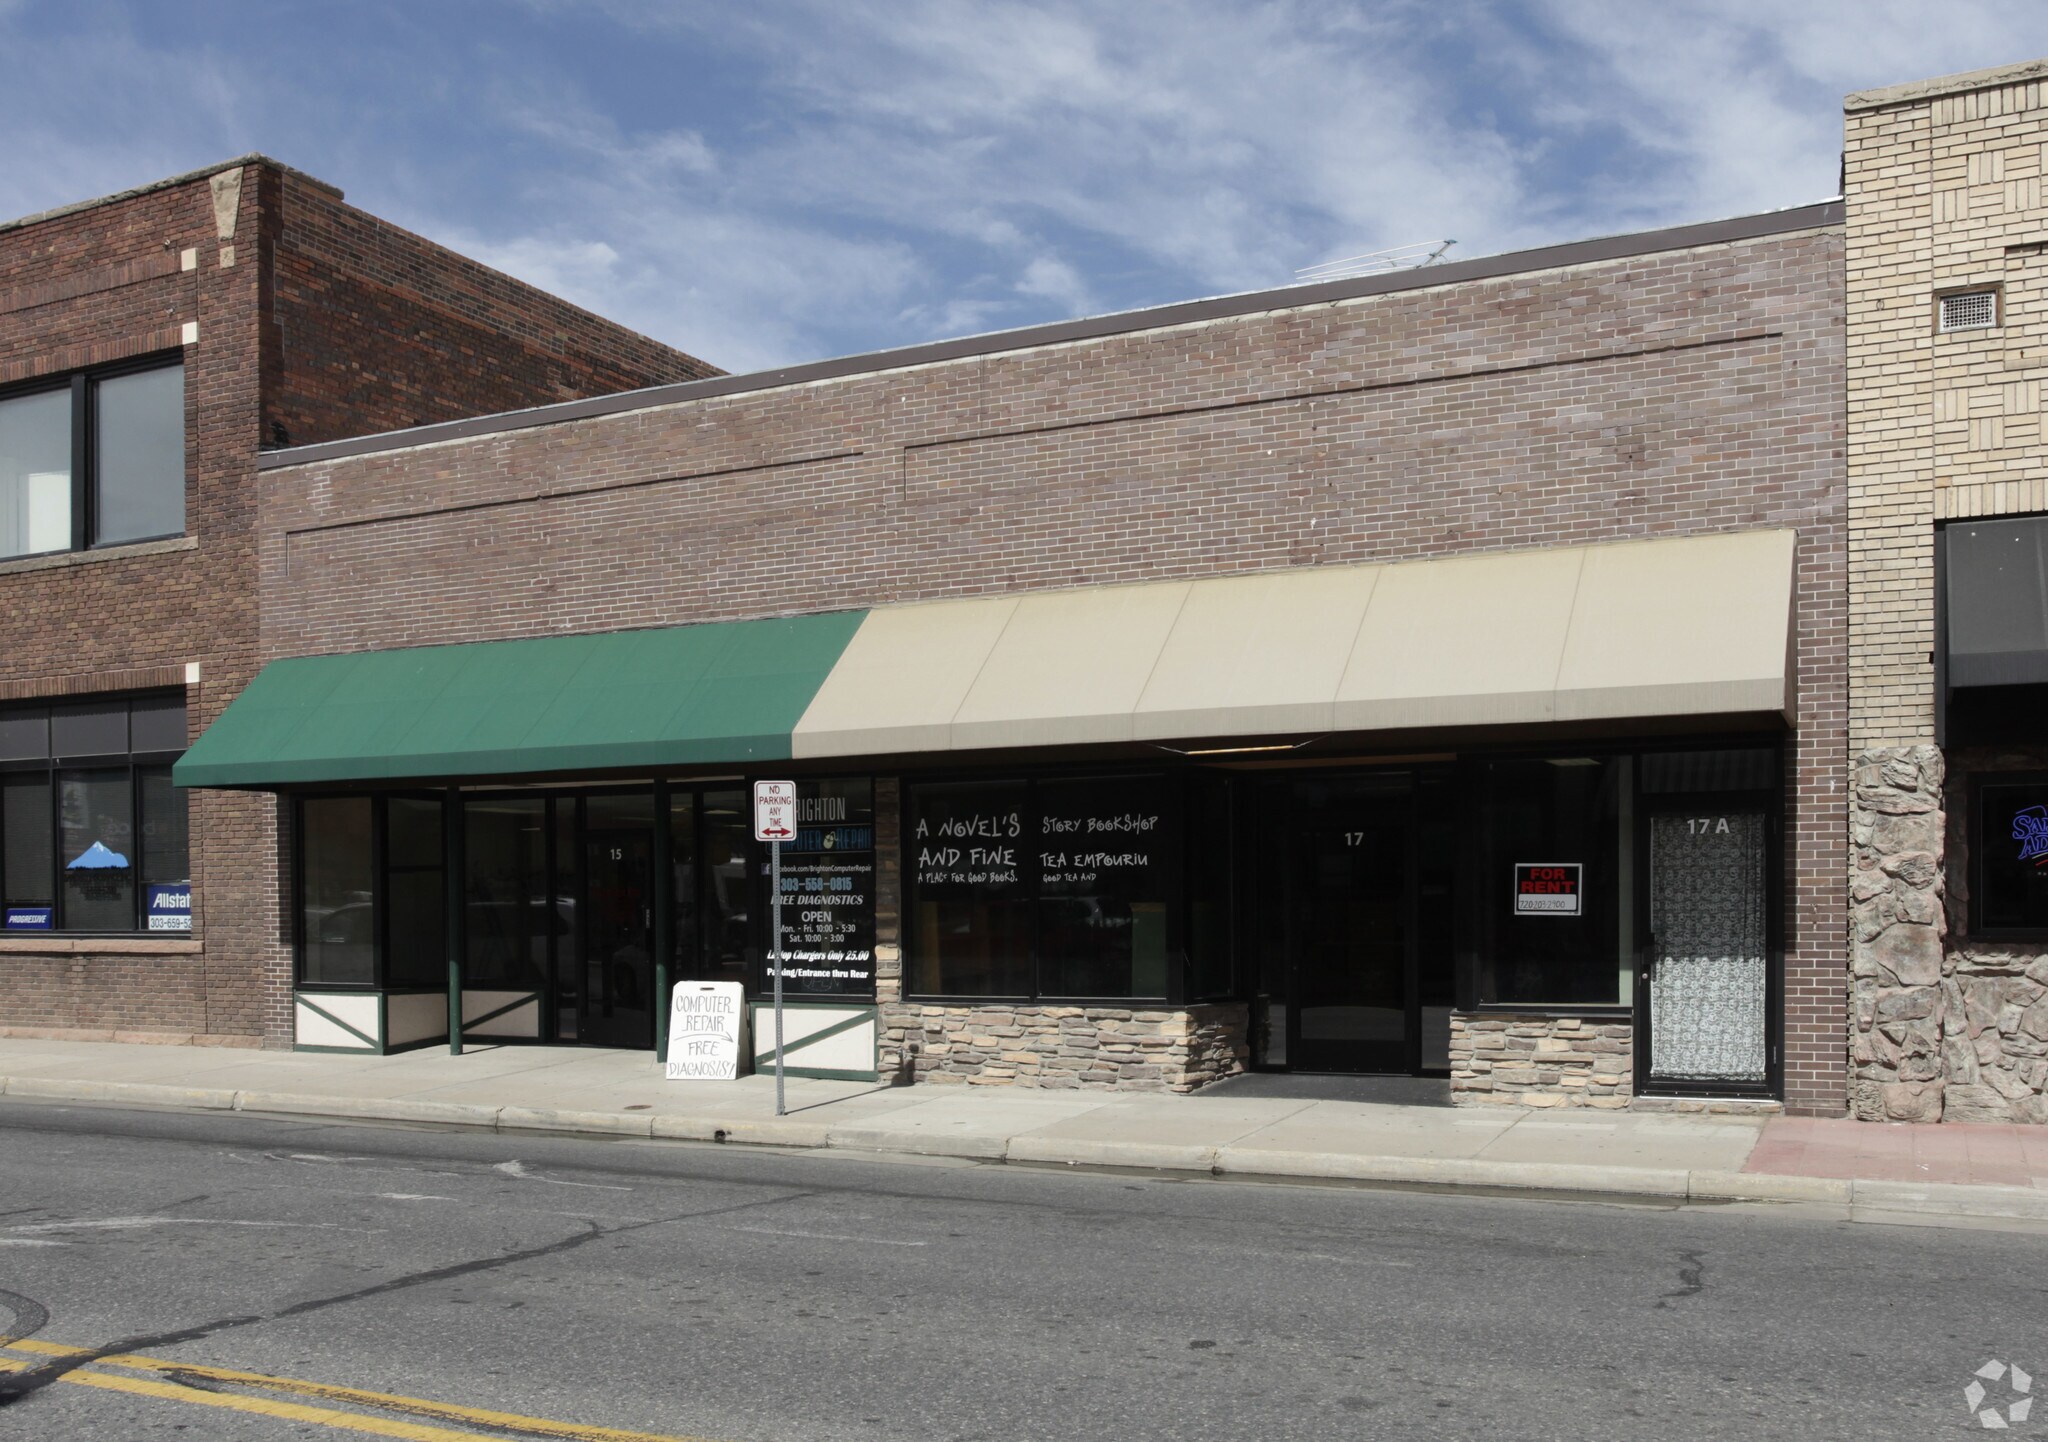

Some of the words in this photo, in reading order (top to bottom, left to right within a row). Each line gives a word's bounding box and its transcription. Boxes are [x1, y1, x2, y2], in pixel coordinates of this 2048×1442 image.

[769, 785, 780, 795] NO
[759, 796, 792, 806] PARKING
[769, 807, 781, 816] ANY
[796, 797, 845, 821] RIGHTON
[769, 817, 782, 827] TIME
[916, 818, 928, 840] A
[938, 812, 1021, 837] NOVEL'S
[1042, 816, 1082, 834] STORY
[1087, 813, 1158, 835] BOOKSHOP
[1344, 832, 1364, 846] 17
[610, 848, 622, 860] 15
[918, 847, 961, 869] AND
[969, 845, 1017, 866] FINE
[1040, 852, 1067, 868] TEA
[779, 864, 872, 874] cebook.com/BrightonComputerRepair
[1530, 868, 1566, 881] FOR
[918, 872, 923, 884] A
[951, 872, 965, 883] FOR
[967, 872, 987, 884] GOOD
[989, 869, 1018, 883] BOOKS.
[1043, 873, 1062, 884] GOOD
[1064, 872, 1078, 882] TEA
[1080, 873, 1097, 882] AND
[1521, 881, 1575, 893] RENT
[152, 893, 191, 908] Allstat
[797, 895, 864, 905] DIAGNOSTICS
[801, 911, 832, 922] OPEN
[150, 918, 192, 928] 303-659-52
[803, 924, 814, 933] Fri.
[815, 924, 833, 932] 10:00
[841, 924, 856, 933] 5:30
[789, 934, 802, 943] Sat.
[804, 934, 822, 943] 10:00
[830, 934, 844, 942] 3:00
[767, 949, 792, 961] Latop
[793, 949, 826, 962] Chargers
[827, 950, 845, 962] Only
[845, 950, 870, 961] 25.00
[767, 967, 831, 978] Paing/Entrance
[832, 969, 848, 978] thru
[850, 969, 869, 979] Rear
[676, 995, 735, 1014] COMPUTER
[682, 1014, 725, 1032] REPAIR
[688, 1040, 720, 1057] FREE
[668, 1060, 736, 1079] DIAGNOSIS!
